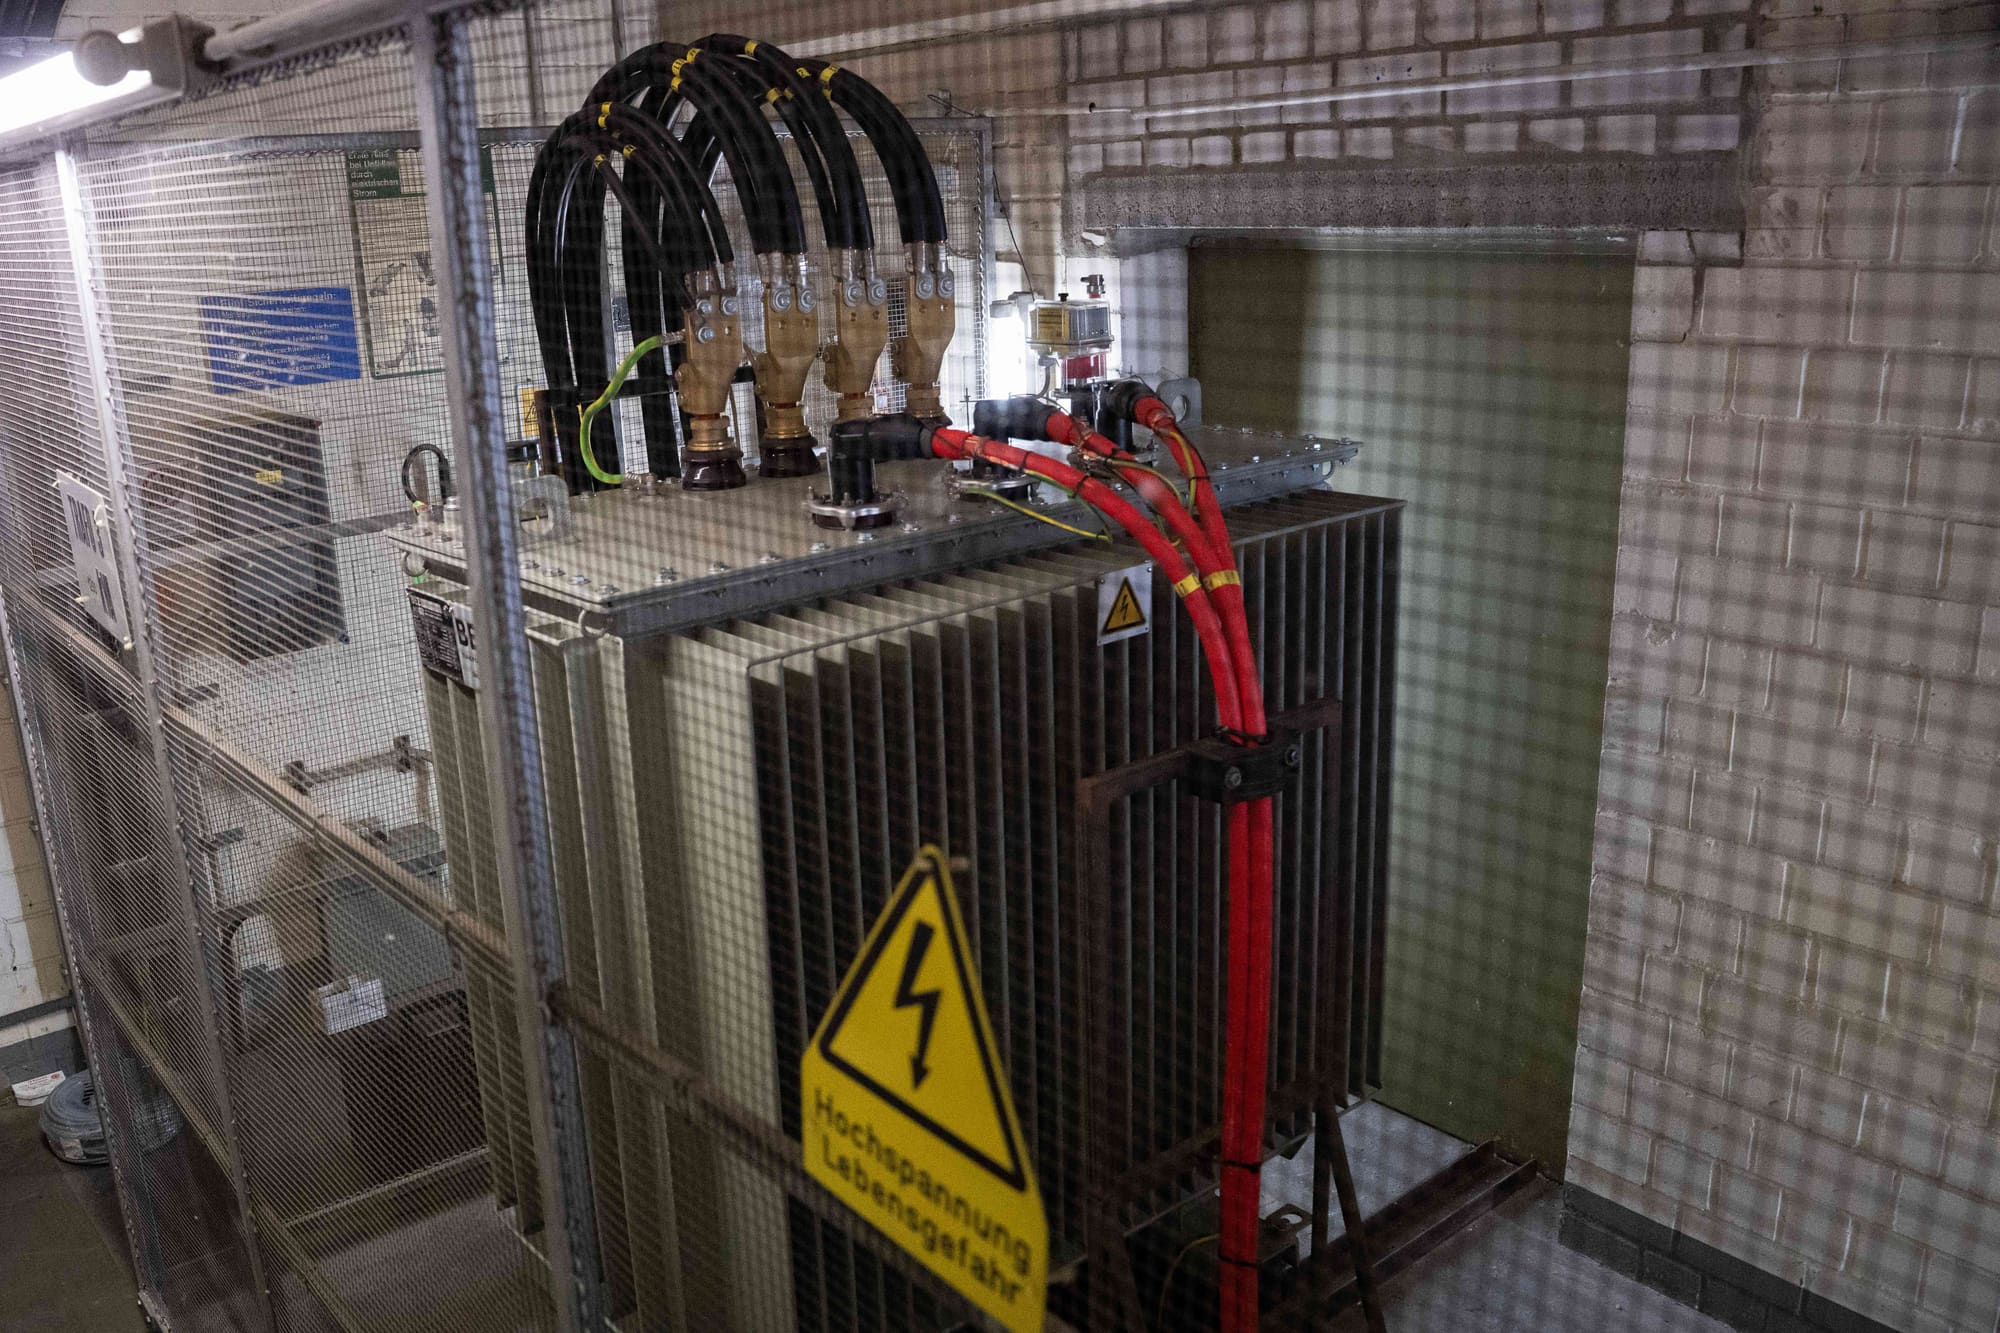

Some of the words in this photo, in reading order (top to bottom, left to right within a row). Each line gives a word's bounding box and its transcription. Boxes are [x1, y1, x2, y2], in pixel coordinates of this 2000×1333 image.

[350, 170, 374, 179] durch
[352, 188, 377, 198] Strom
[814, 1087, 1032, 1278] Hochspannung
[821, 1132, 1023, 1305] Lebensgefahr
